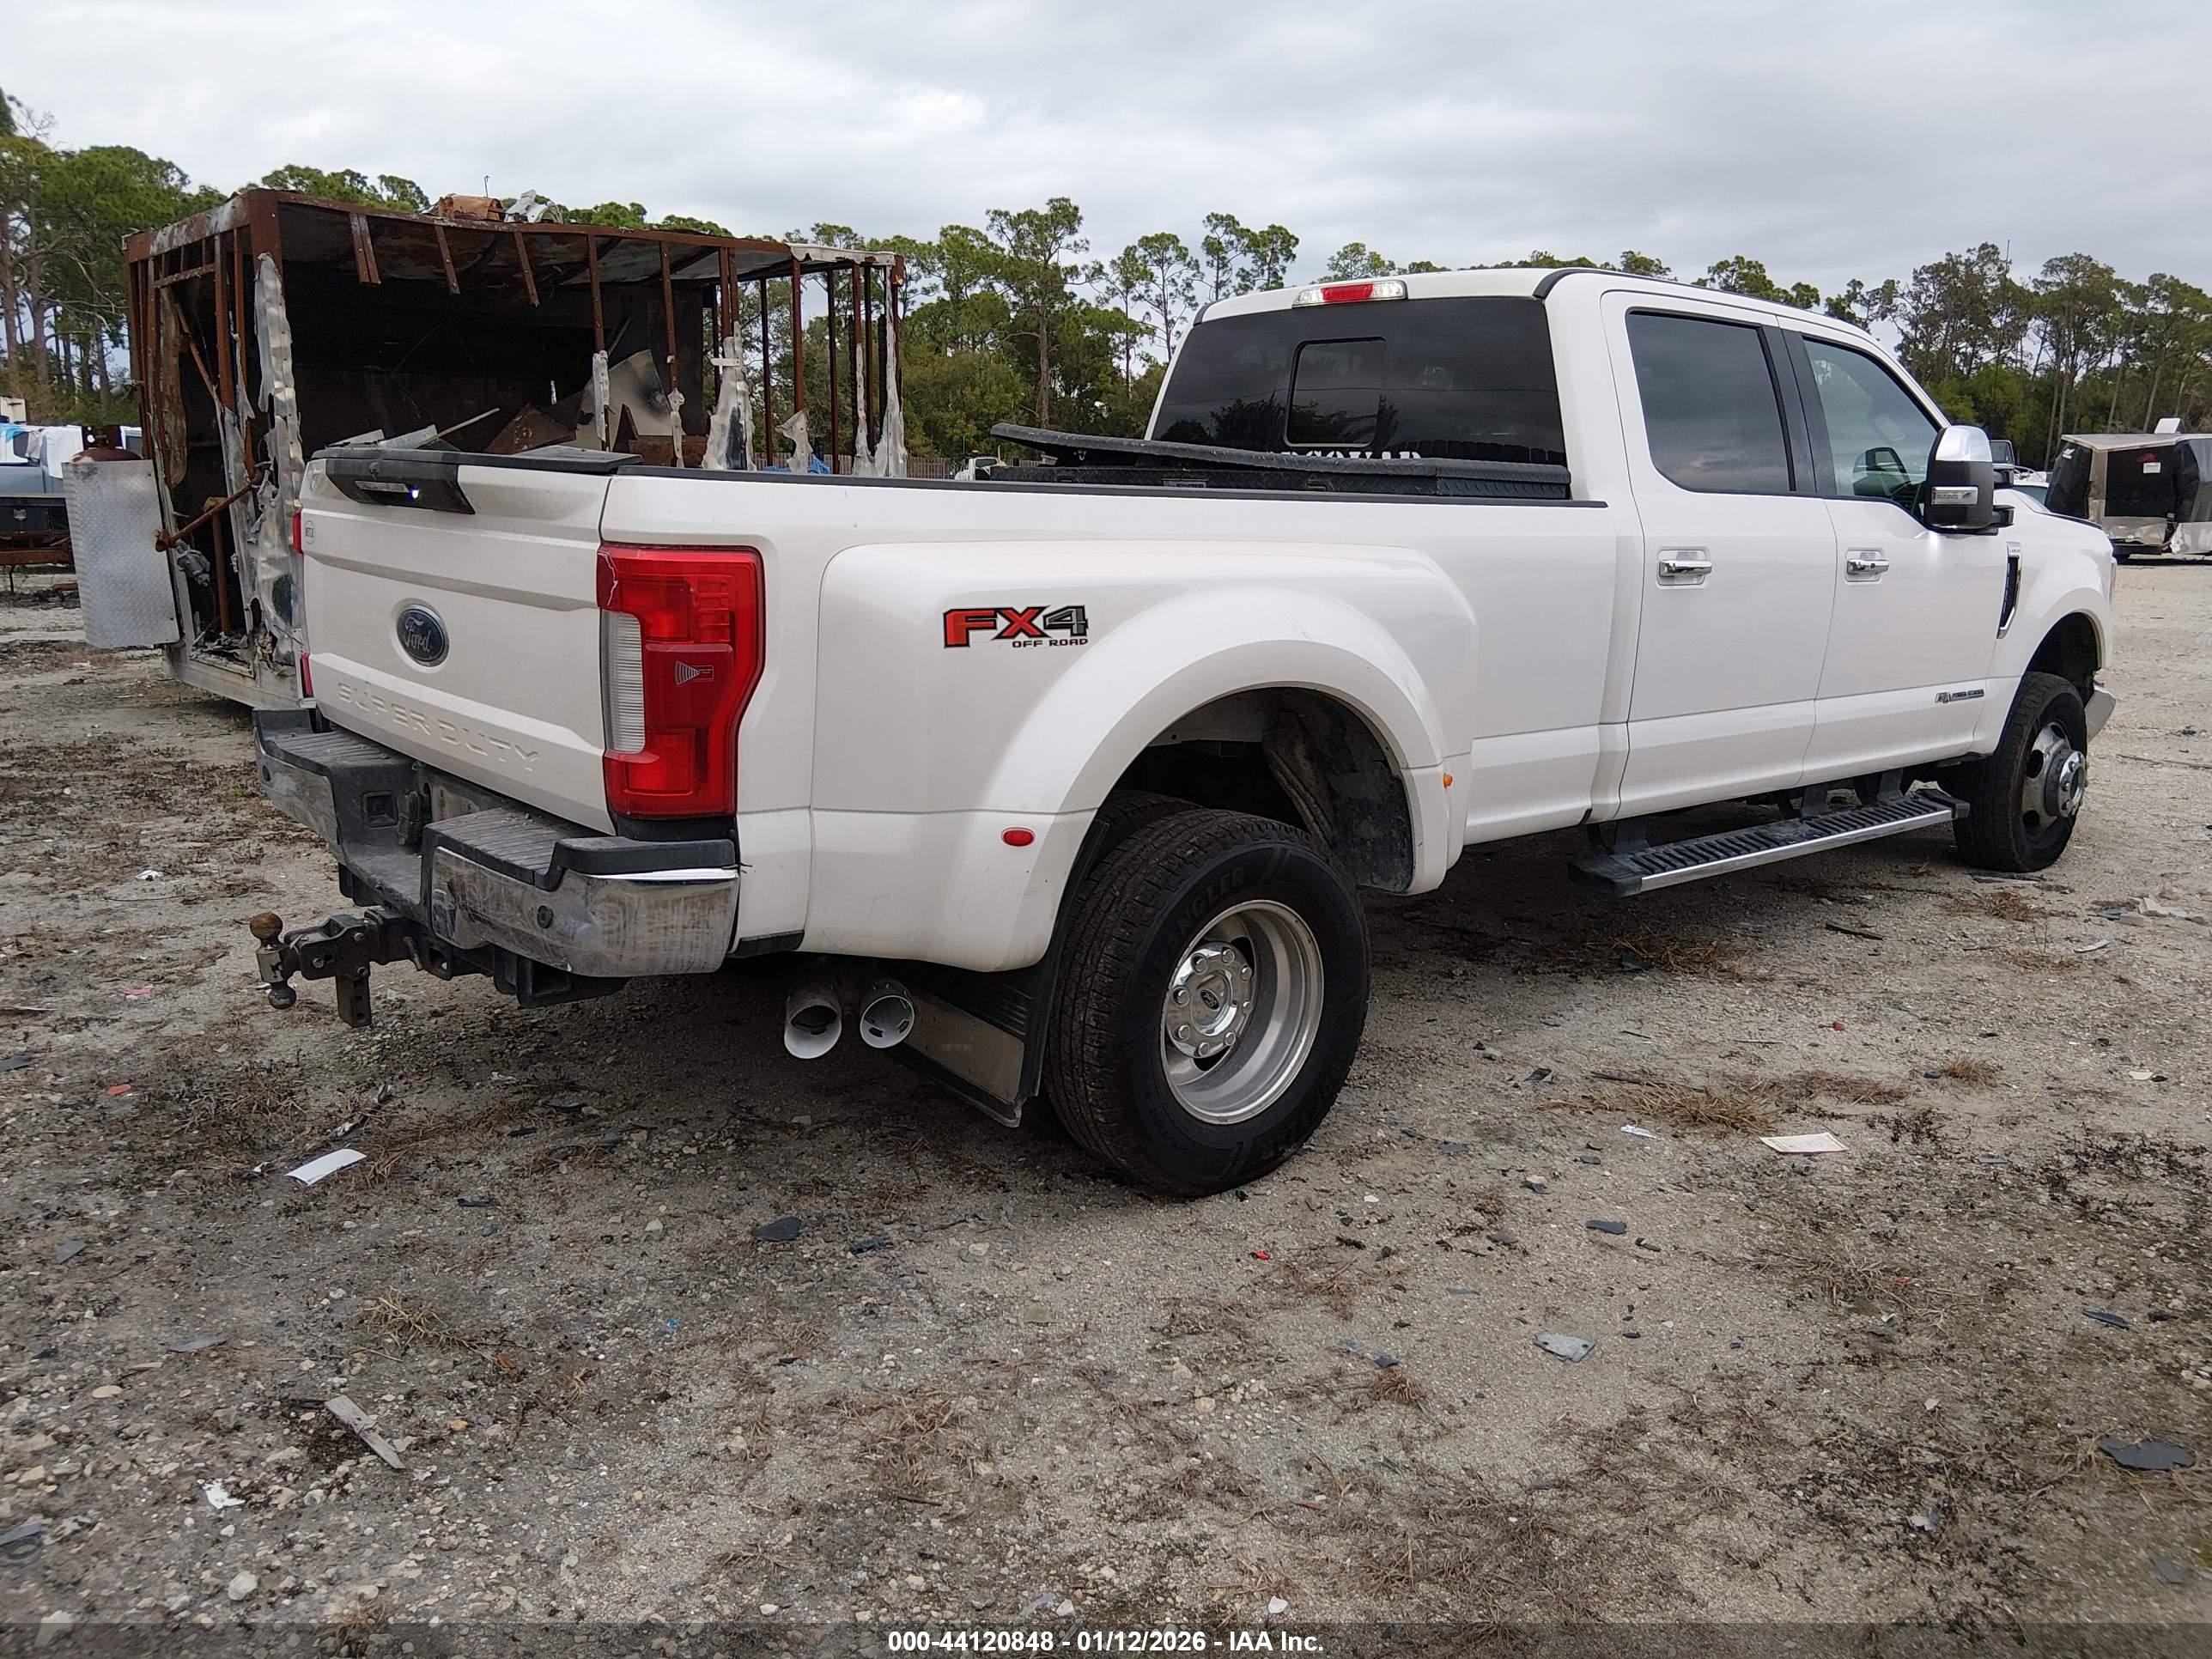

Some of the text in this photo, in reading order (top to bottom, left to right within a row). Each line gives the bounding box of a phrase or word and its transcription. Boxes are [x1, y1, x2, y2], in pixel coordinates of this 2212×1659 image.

[404, 616, 433, 653] Ford
[943, 605, 1089, 648] FX4
[1012, 638, 1089, 648] OFF ROAD
[337, 681, 540, 773] SUPER DUTY
